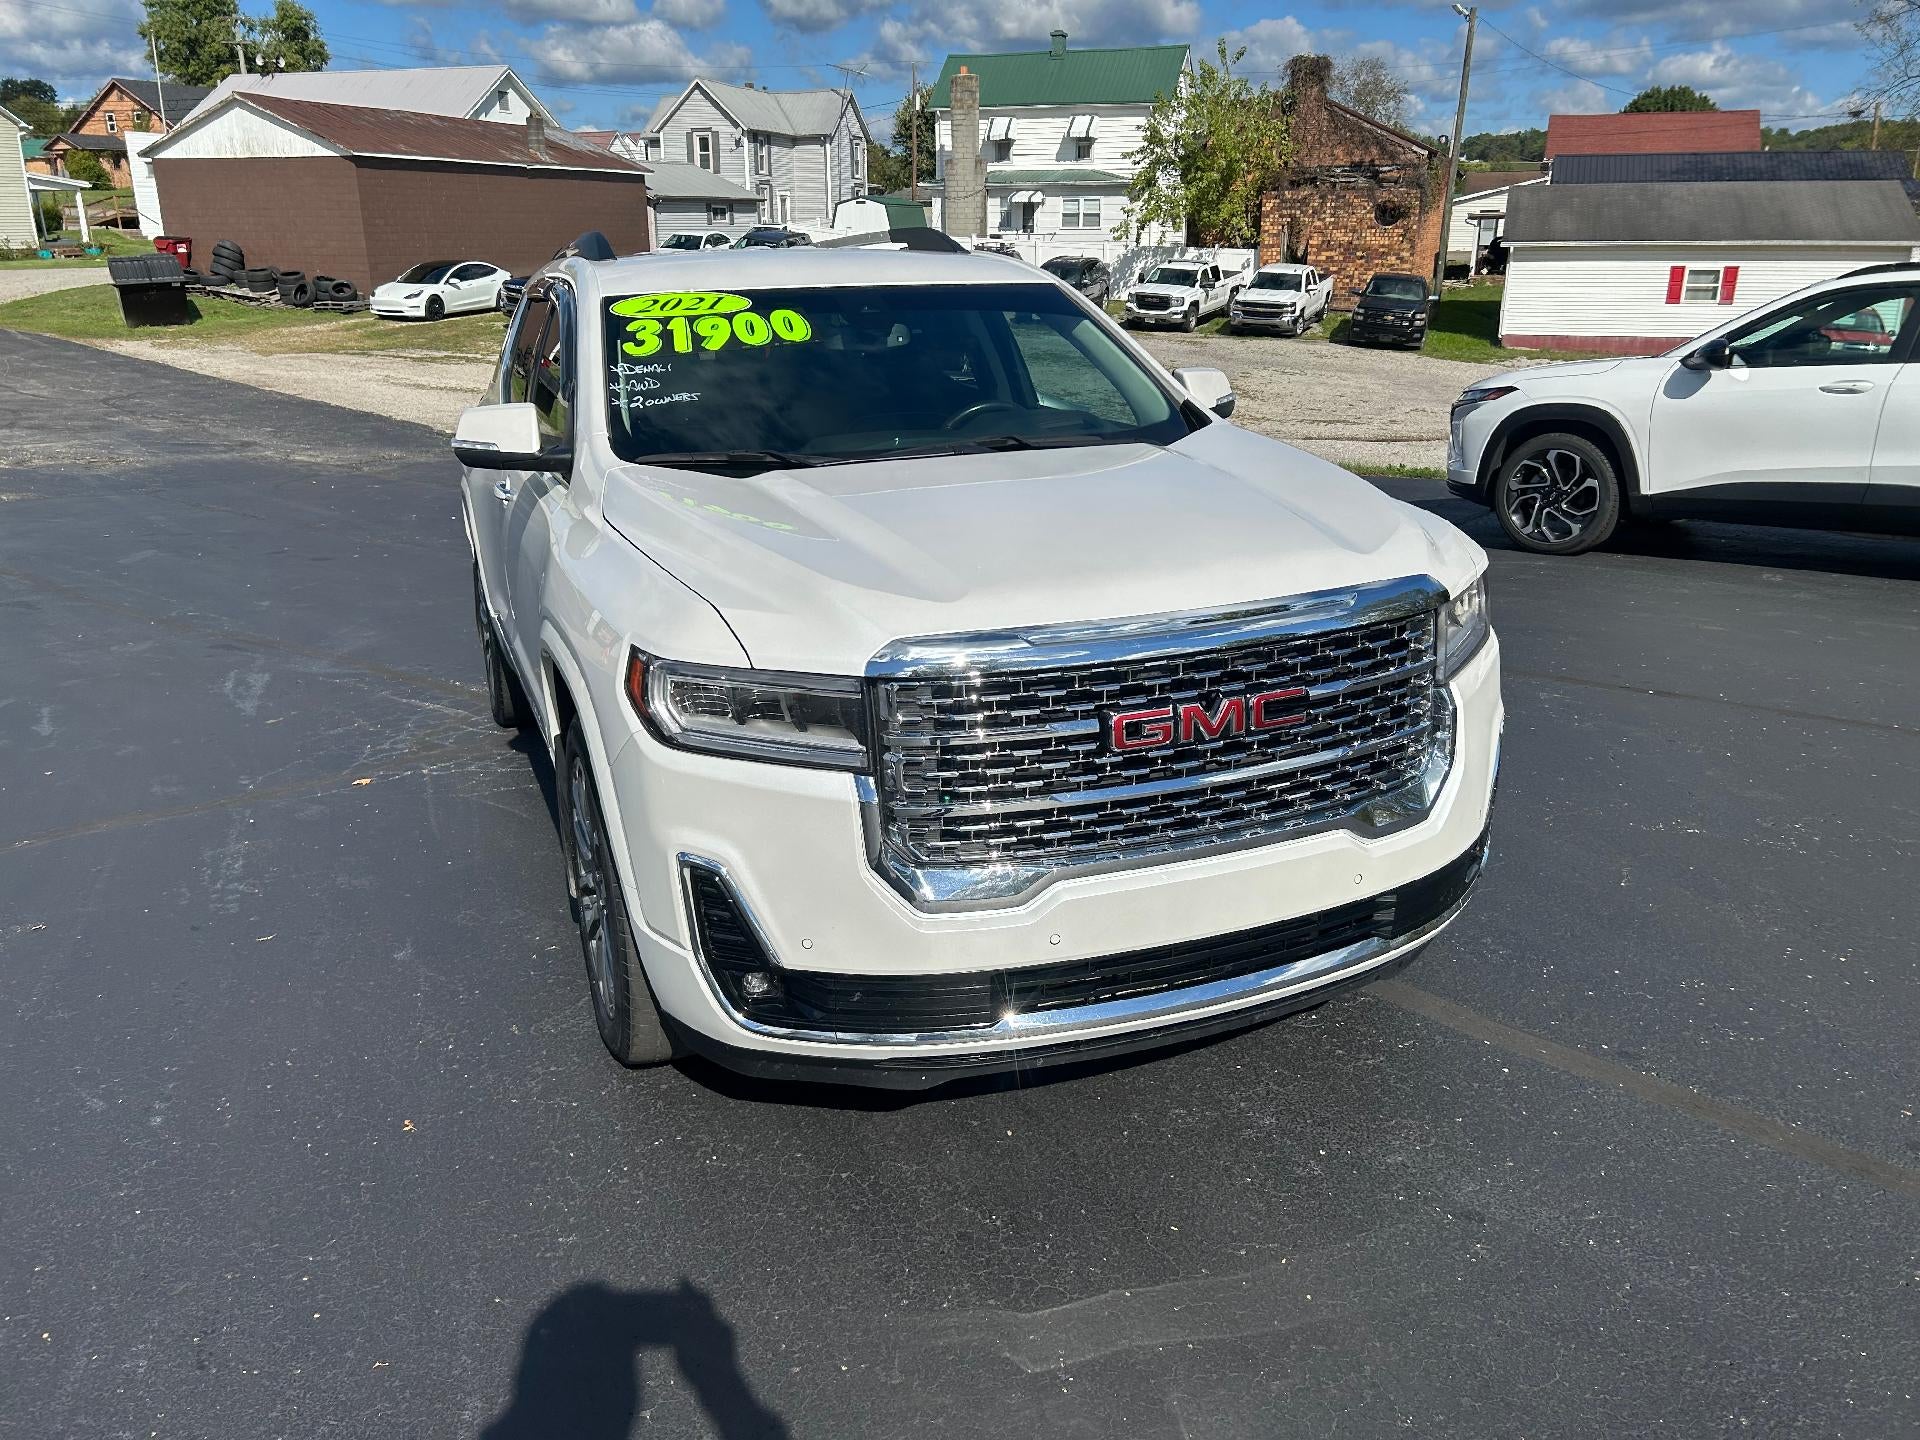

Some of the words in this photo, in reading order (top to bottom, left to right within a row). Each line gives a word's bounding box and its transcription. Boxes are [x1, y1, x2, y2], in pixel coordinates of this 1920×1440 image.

[633, 297, 725, 313] 2021
[622, 309, 812, 356] 31900
[1111, 686, 1307, 751] GMC
